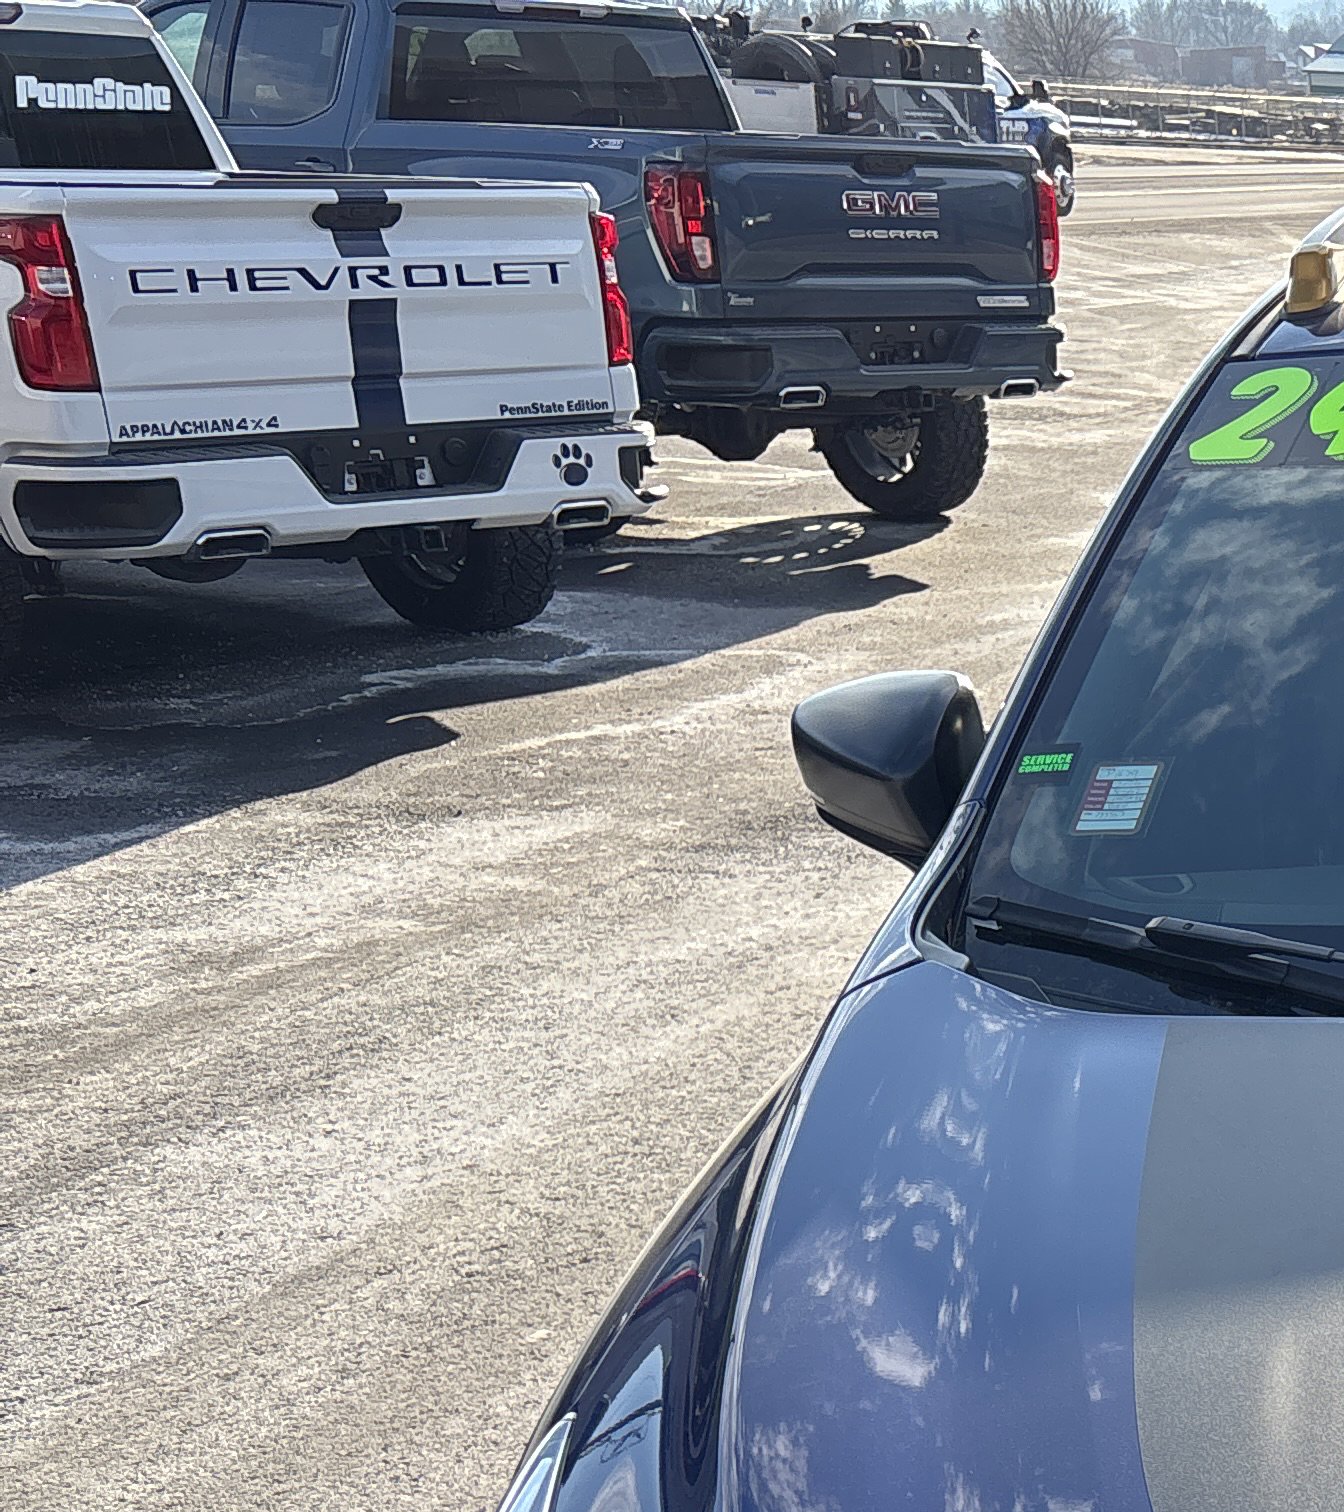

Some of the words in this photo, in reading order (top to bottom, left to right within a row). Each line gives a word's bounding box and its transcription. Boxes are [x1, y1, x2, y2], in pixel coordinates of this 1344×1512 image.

[15, 75, 172, 112] PennState
[842, 191, 940, 218] GMC
[848, 229, 939, 239] SIERRA
[128, 261, 570, 294] CHEVROLET
[499, 402, 565, 416] PennState
[567, 399, 609, 412] Edition
[1021, 753, 1074, 765] SERVICE
[1018, 763, 1071, 774] COMPLETED
